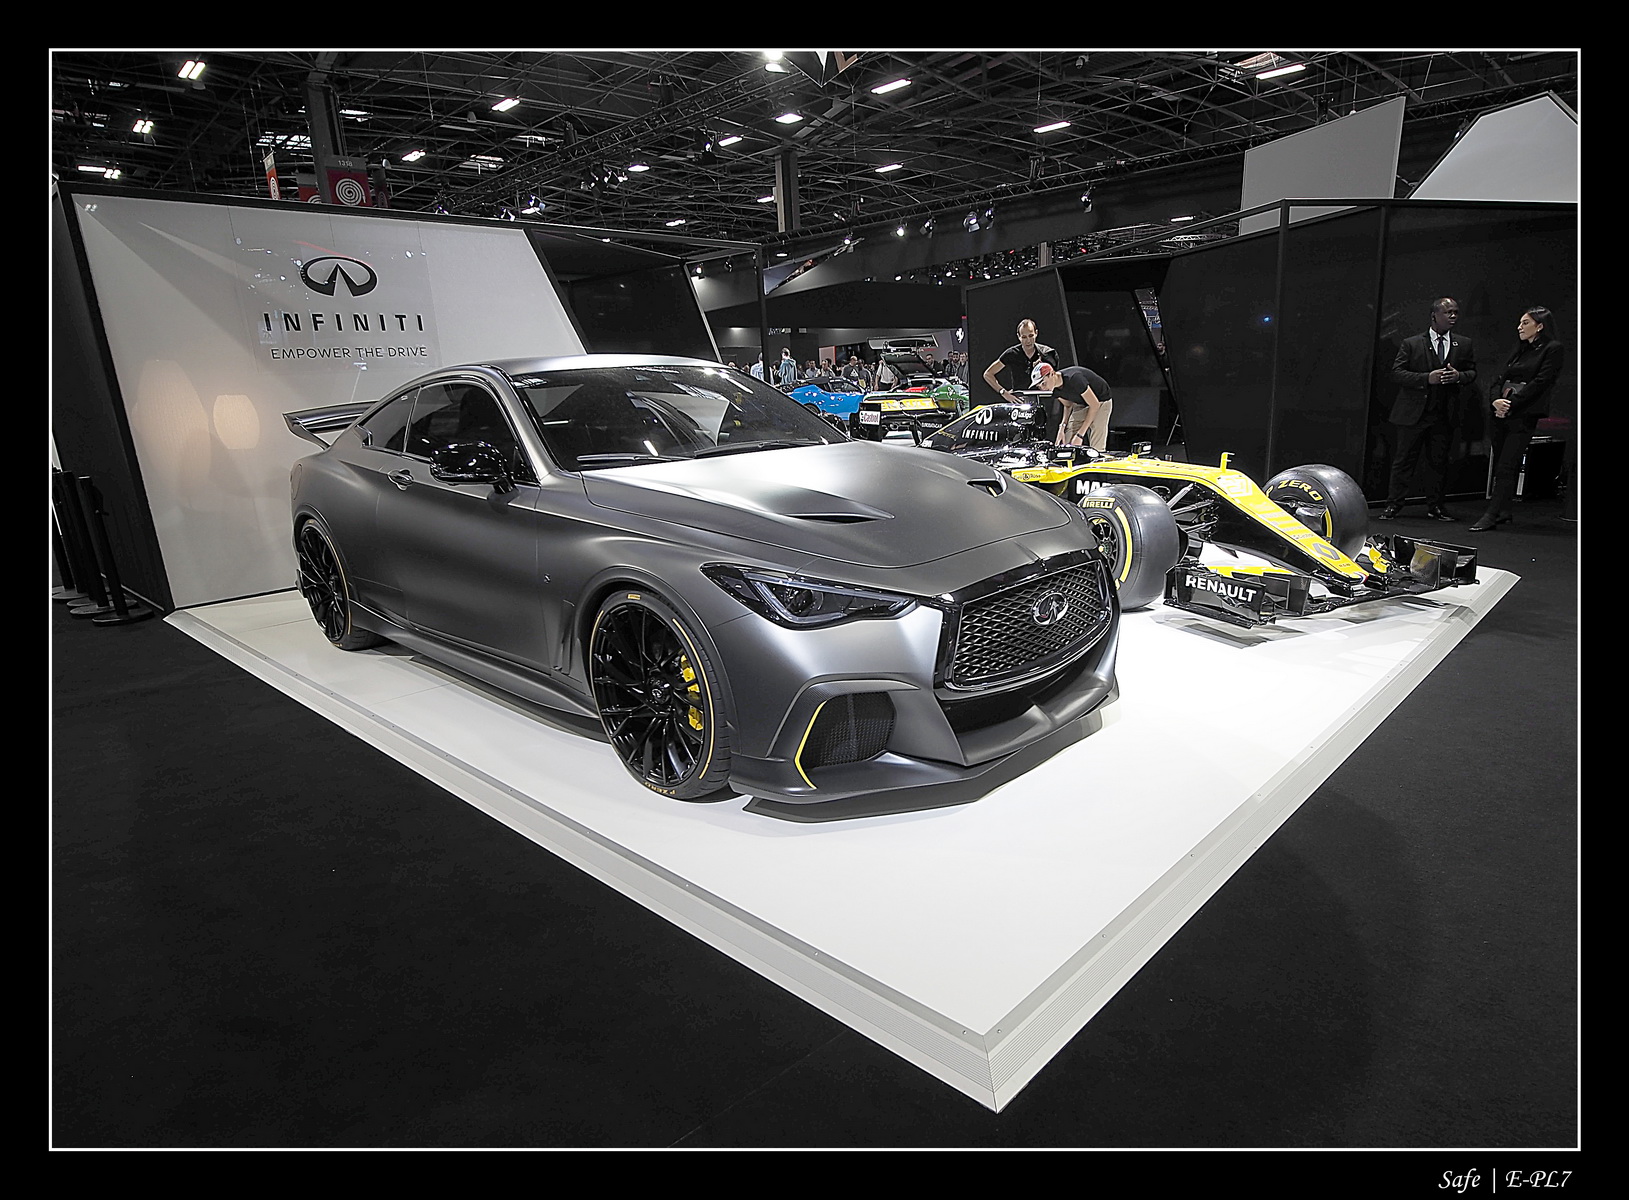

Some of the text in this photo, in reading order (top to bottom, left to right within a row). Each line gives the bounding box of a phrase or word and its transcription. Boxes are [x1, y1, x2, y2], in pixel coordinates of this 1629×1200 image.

[263, 312, 424, 332] INFINITI
[271, 346, 428, 360] EMPOWER THE DRIVE
[962, 429, 998, 441] INFINITI
[1277, 479, 1324, 501] ZERO
[1082, 496, 1116, 509] PIRELLI
[1185, 574, 1257, 602] RENAULT
